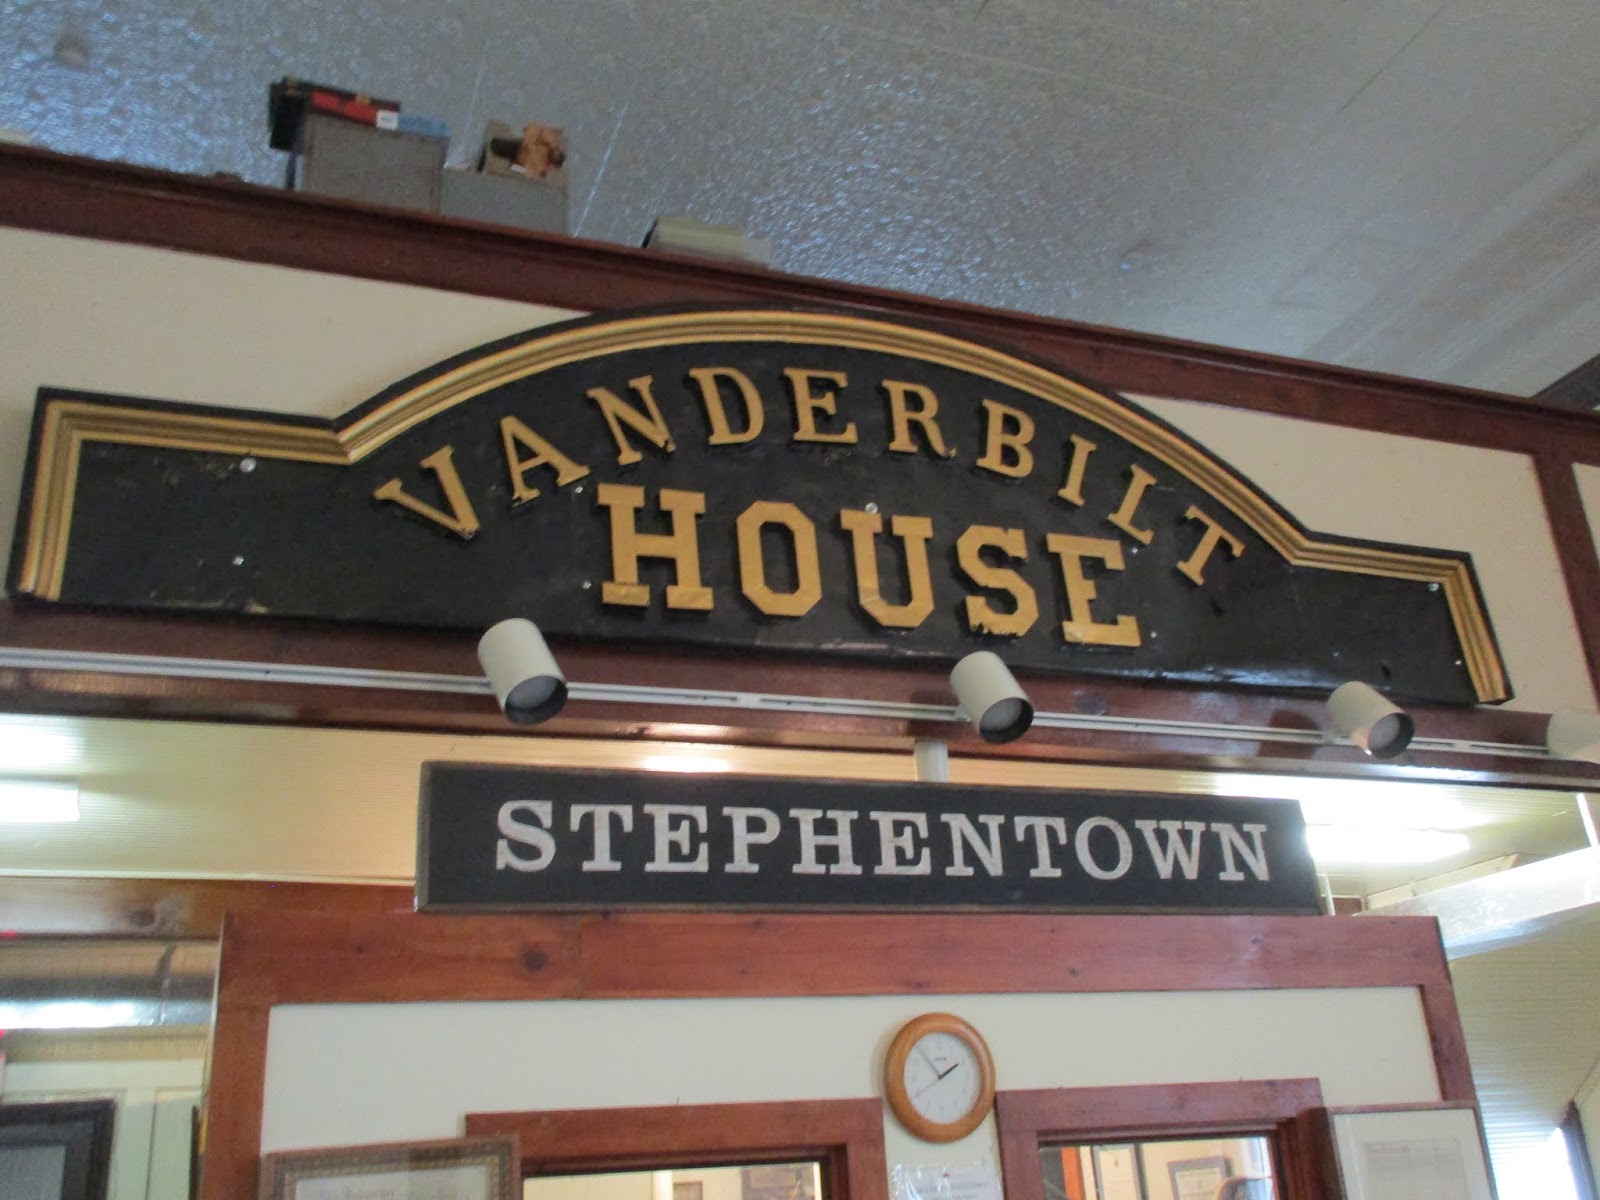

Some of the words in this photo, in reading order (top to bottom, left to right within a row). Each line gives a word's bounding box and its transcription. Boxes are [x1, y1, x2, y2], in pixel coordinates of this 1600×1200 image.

[374, 367, 1245, 586] VANDERBILT
[597, 483, 1141, 647] HOUSE
[496, 800, 1269, 881] STEPHENTOWN
